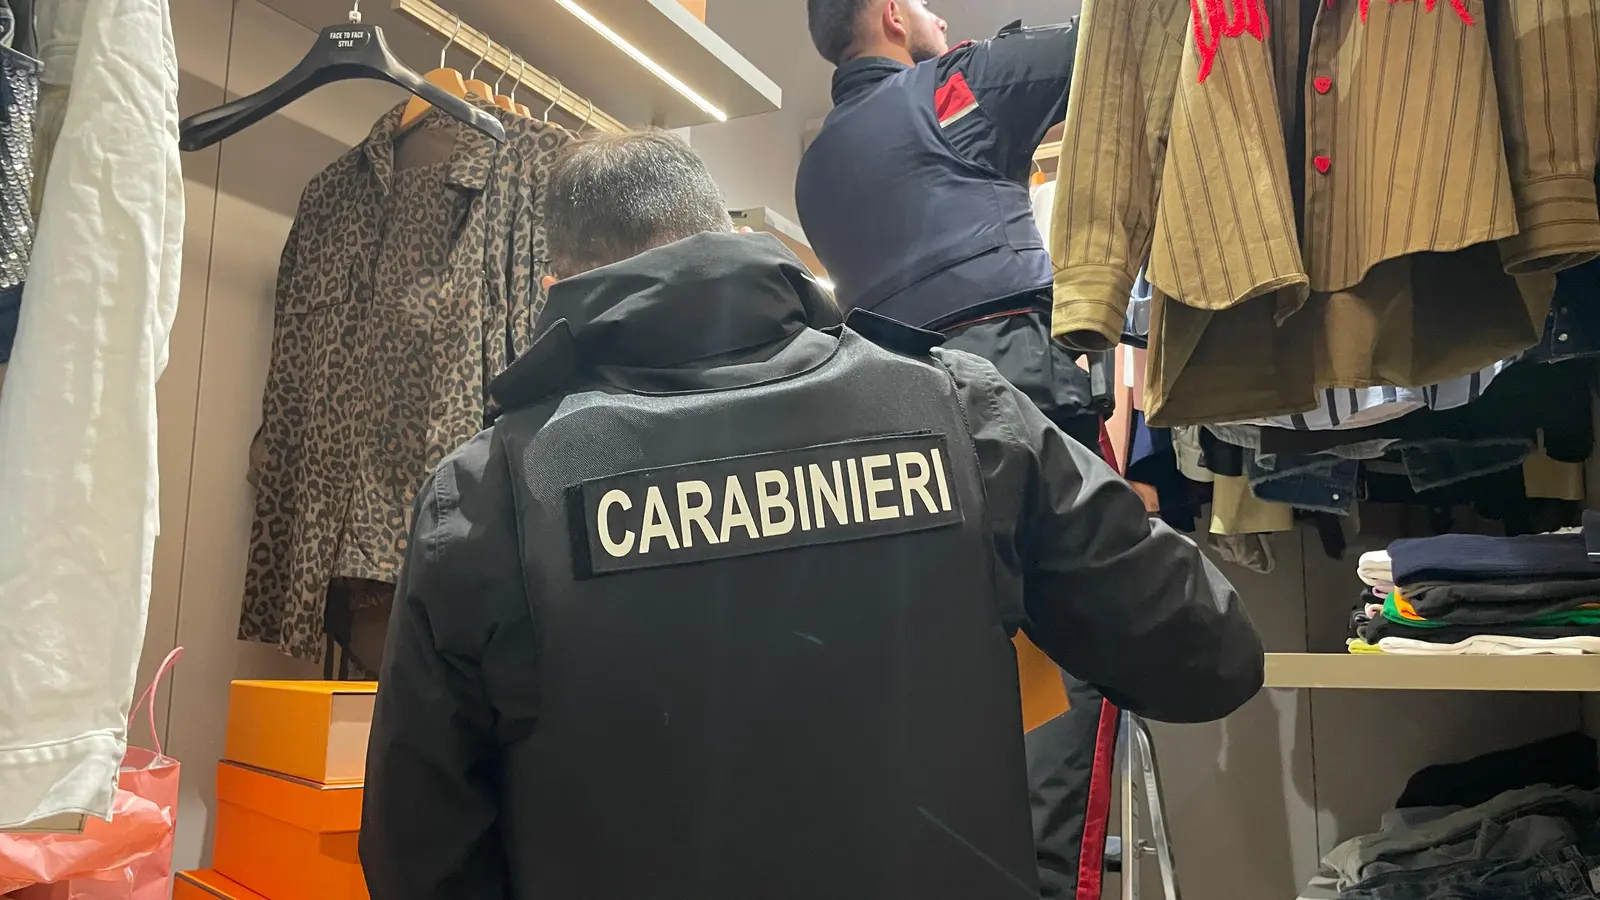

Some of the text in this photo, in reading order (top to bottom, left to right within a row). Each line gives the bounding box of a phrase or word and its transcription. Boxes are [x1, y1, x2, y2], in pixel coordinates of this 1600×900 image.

[351, 31, 364, 39] FACE
[338, 40, 354, 48] STYLE
[597, 448, 952, 557] CARABINIERI
